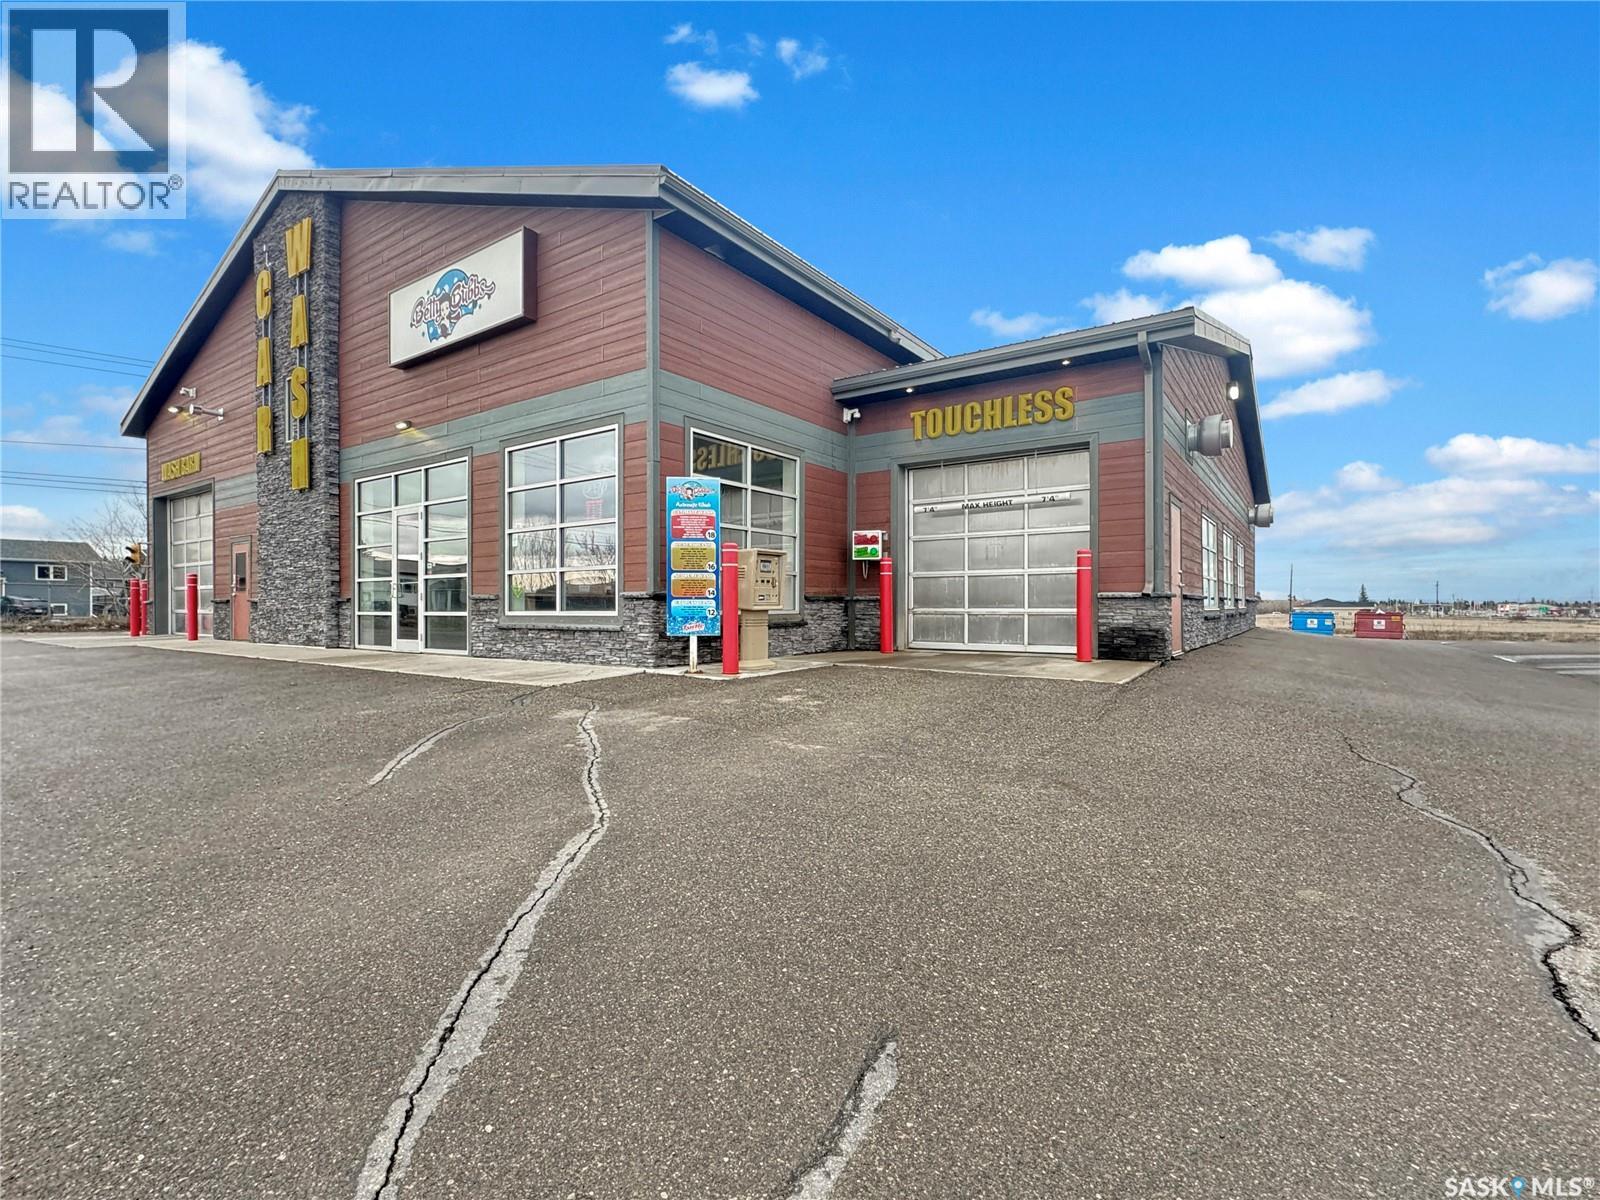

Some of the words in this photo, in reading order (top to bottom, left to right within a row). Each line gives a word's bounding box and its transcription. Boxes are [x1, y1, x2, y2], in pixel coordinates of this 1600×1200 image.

[256, 270, 273, 454] CAR
[910, 386, 1075, 441] TOUCHLESS
[961, 502, 981, 510] MAX
[983, 499, 1014, 508] HEIGHT
[707, 531, 716, 539] 18
[707, 563, 716, 571] 16
[707, 589, 716, 597] 14
